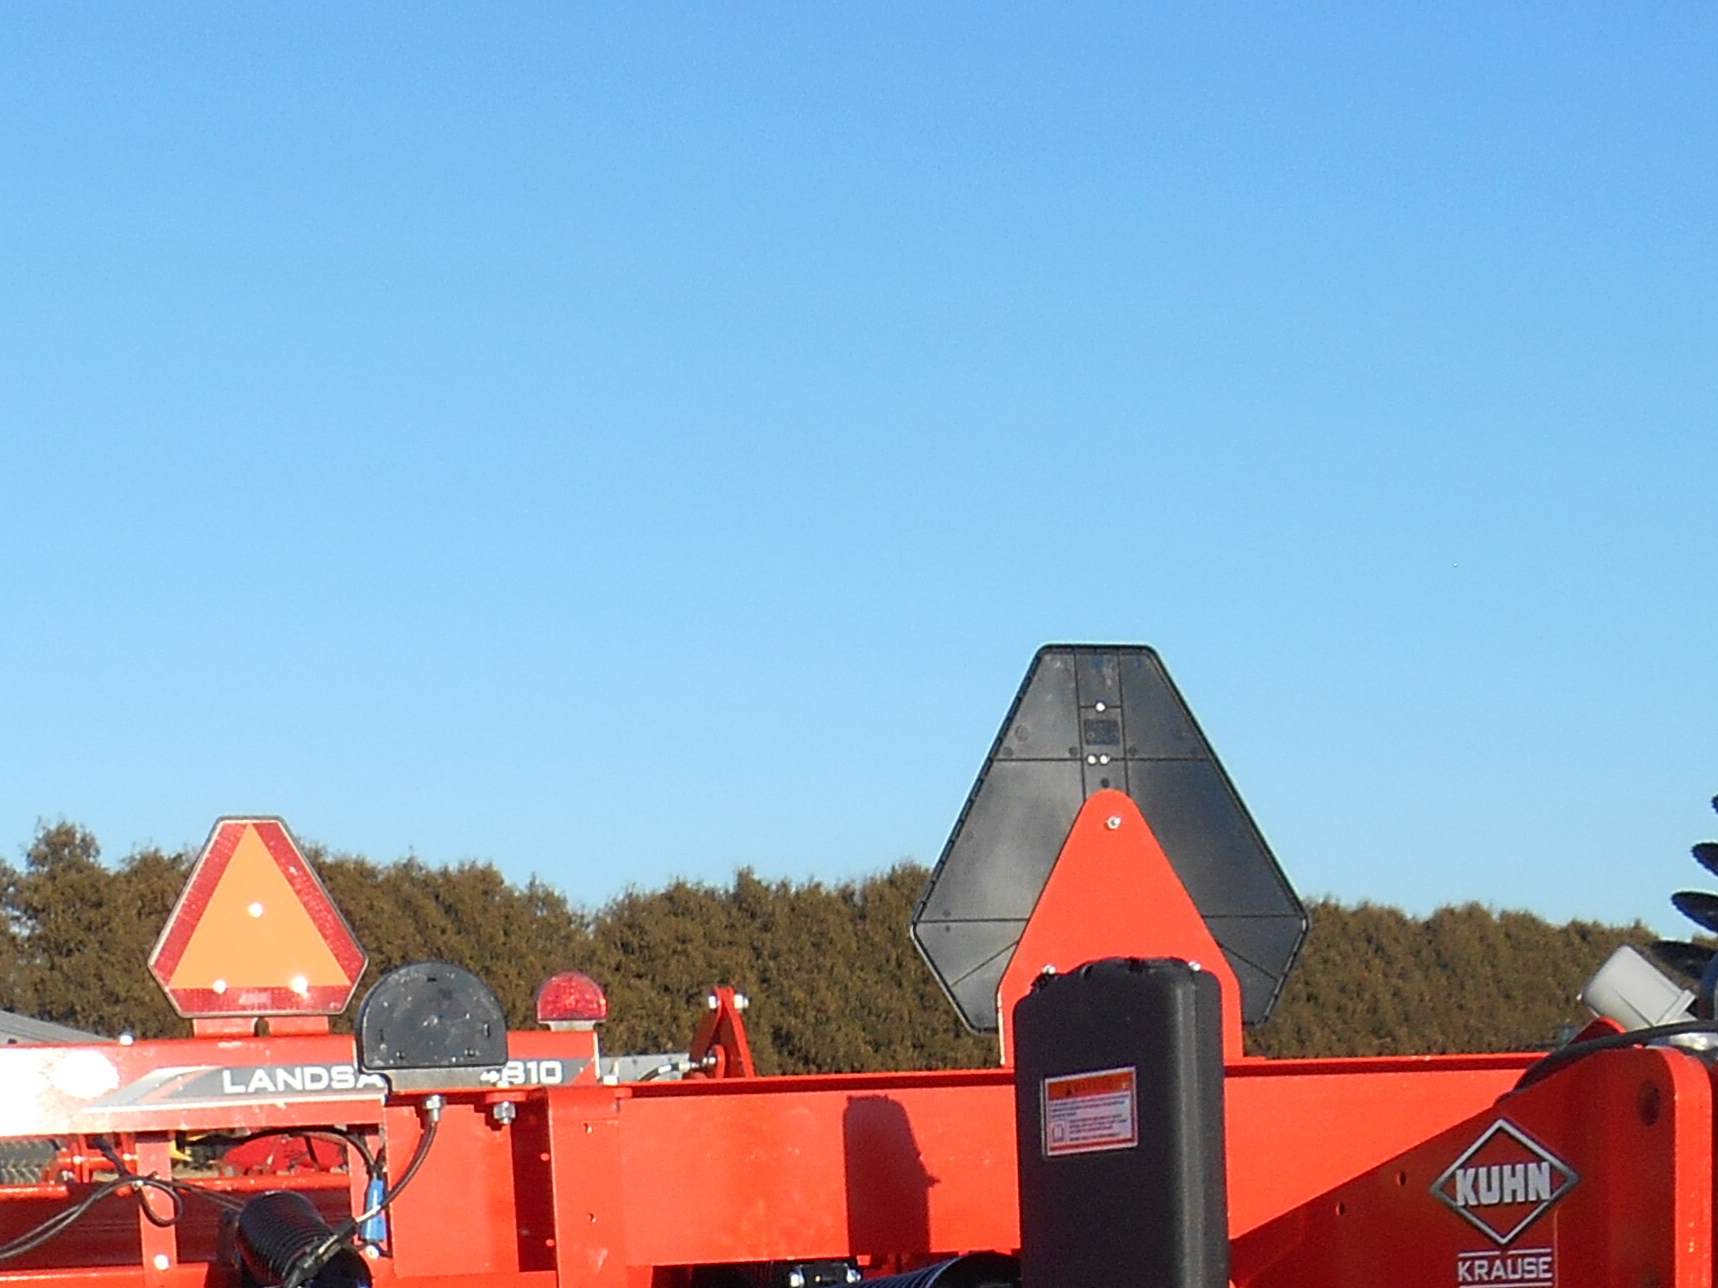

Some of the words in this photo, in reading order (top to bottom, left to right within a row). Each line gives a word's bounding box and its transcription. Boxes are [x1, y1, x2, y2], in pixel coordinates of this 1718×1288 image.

[221, 1064, 385, 1094] LANDSA
[1455, 1160, 1551, 1208] KUHN
[1457, 1256, 1553, 1283] KRAUSE
